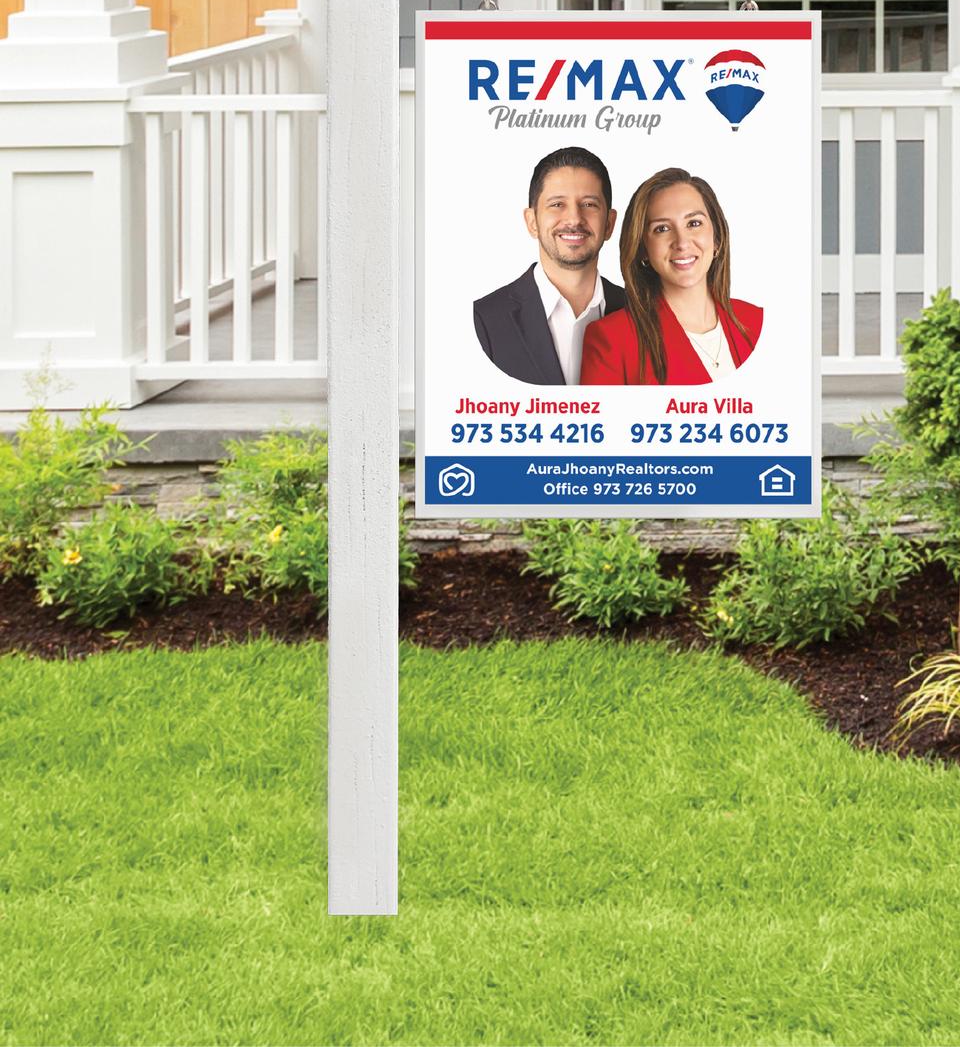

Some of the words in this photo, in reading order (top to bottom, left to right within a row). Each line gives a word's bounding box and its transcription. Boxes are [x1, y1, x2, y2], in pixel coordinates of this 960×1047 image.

[710, 68, 760, 84] RE/MAX
[488, 105, 587, 130] Platinum
[595, 105, 661, 135] Group
[455, 398, 520, 416] Jhoany
[525, 398, 600, 414] Jimenez
[666, 398, 707, 414] Aura
[714, 398, 753, 414] Villa
[451, 423, 493, 443] 973
[500, 423, 543, 443] 534
[550, 423, 604, 443] 4216
[631, 423, 672, 443] 973
[680, 423, 722, 443] 234
[730, 423, 789, 443] 6073
[526, 462, 714, 477] AuraJhoanyRealtors.com
[543, 482, 588, 496] Office
[593, 482, 621, 496] 973
[625, 482, 653, 495] 726
[657, 482, 697, 496] 5700
